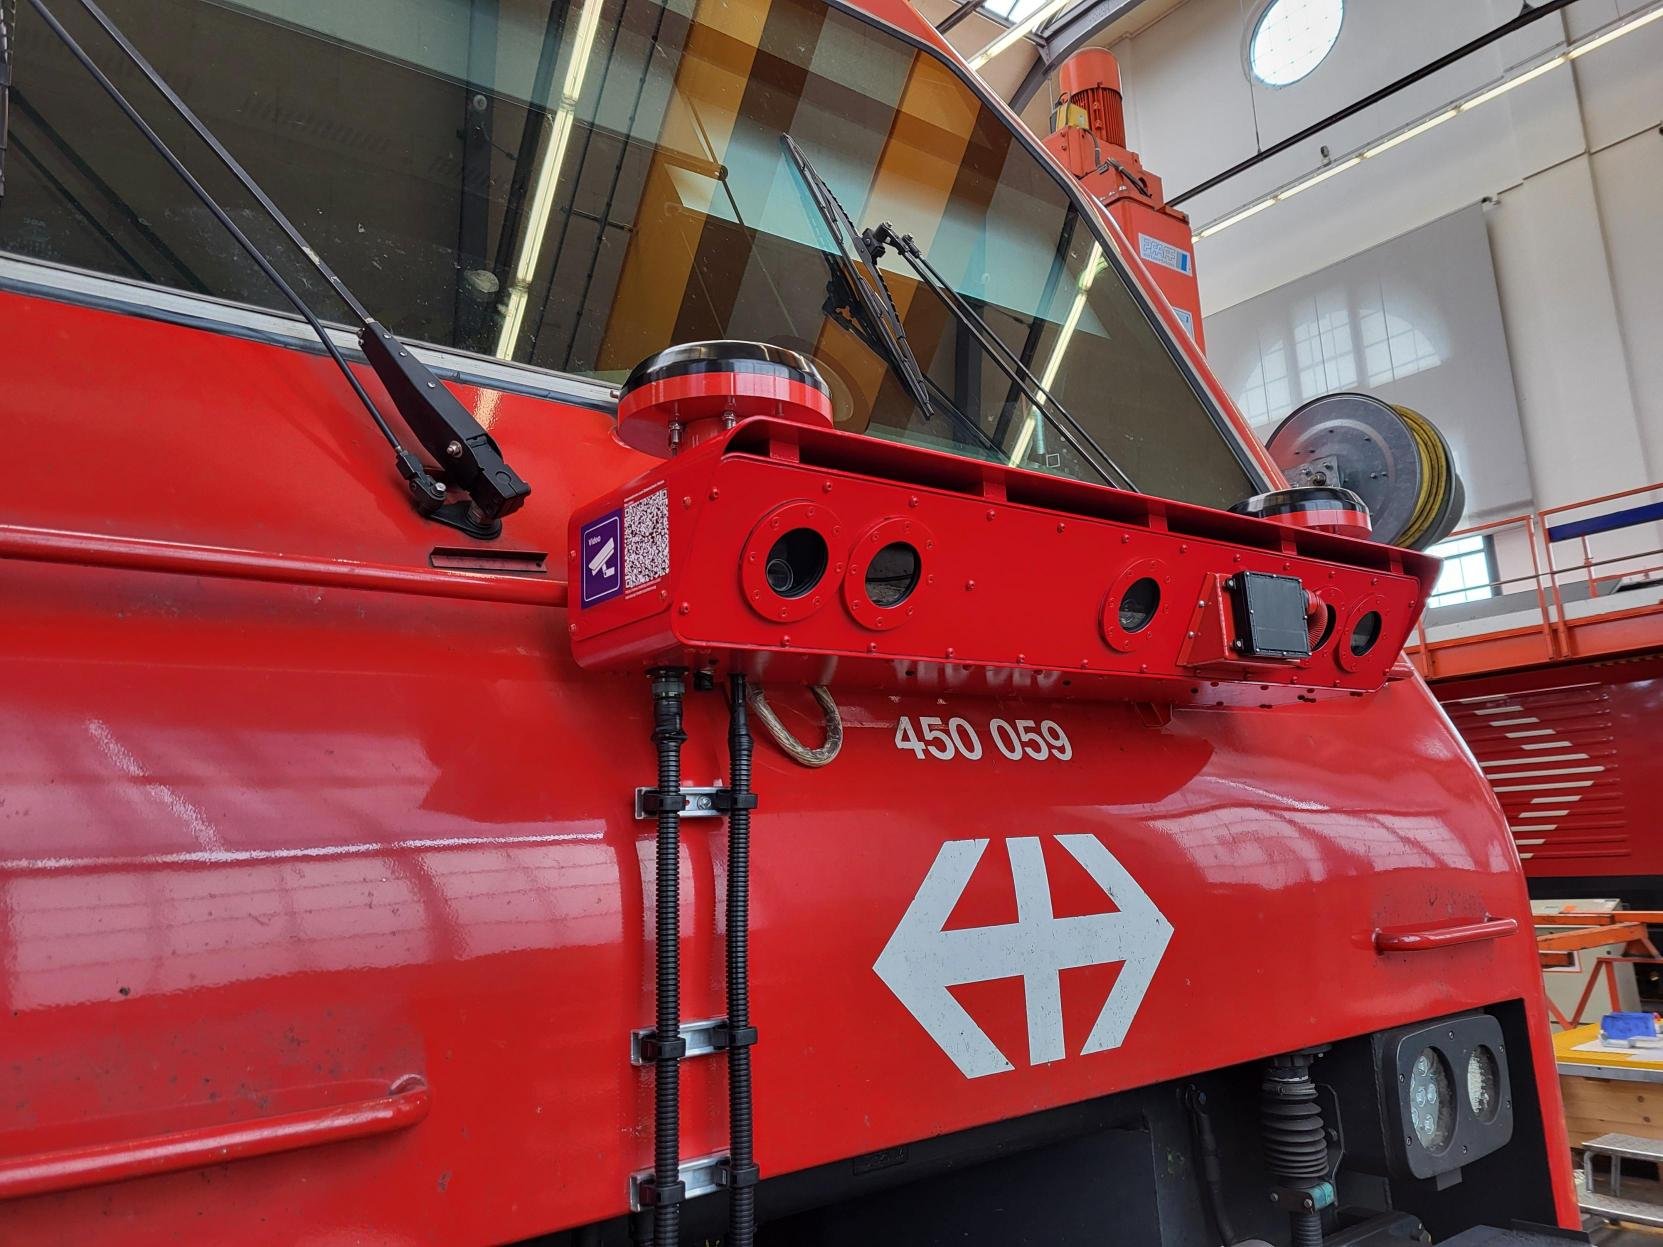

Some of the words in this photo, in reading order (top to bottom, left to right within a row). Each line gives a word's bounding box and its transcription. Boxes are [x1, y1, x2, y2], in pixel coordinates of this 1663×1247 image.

[1143, 238, 1176, 261] PFAFF
[588, 535, 602, 546] Video
[894, 715, 983, 761] 450
[989, 717, 1074, 762] 059
